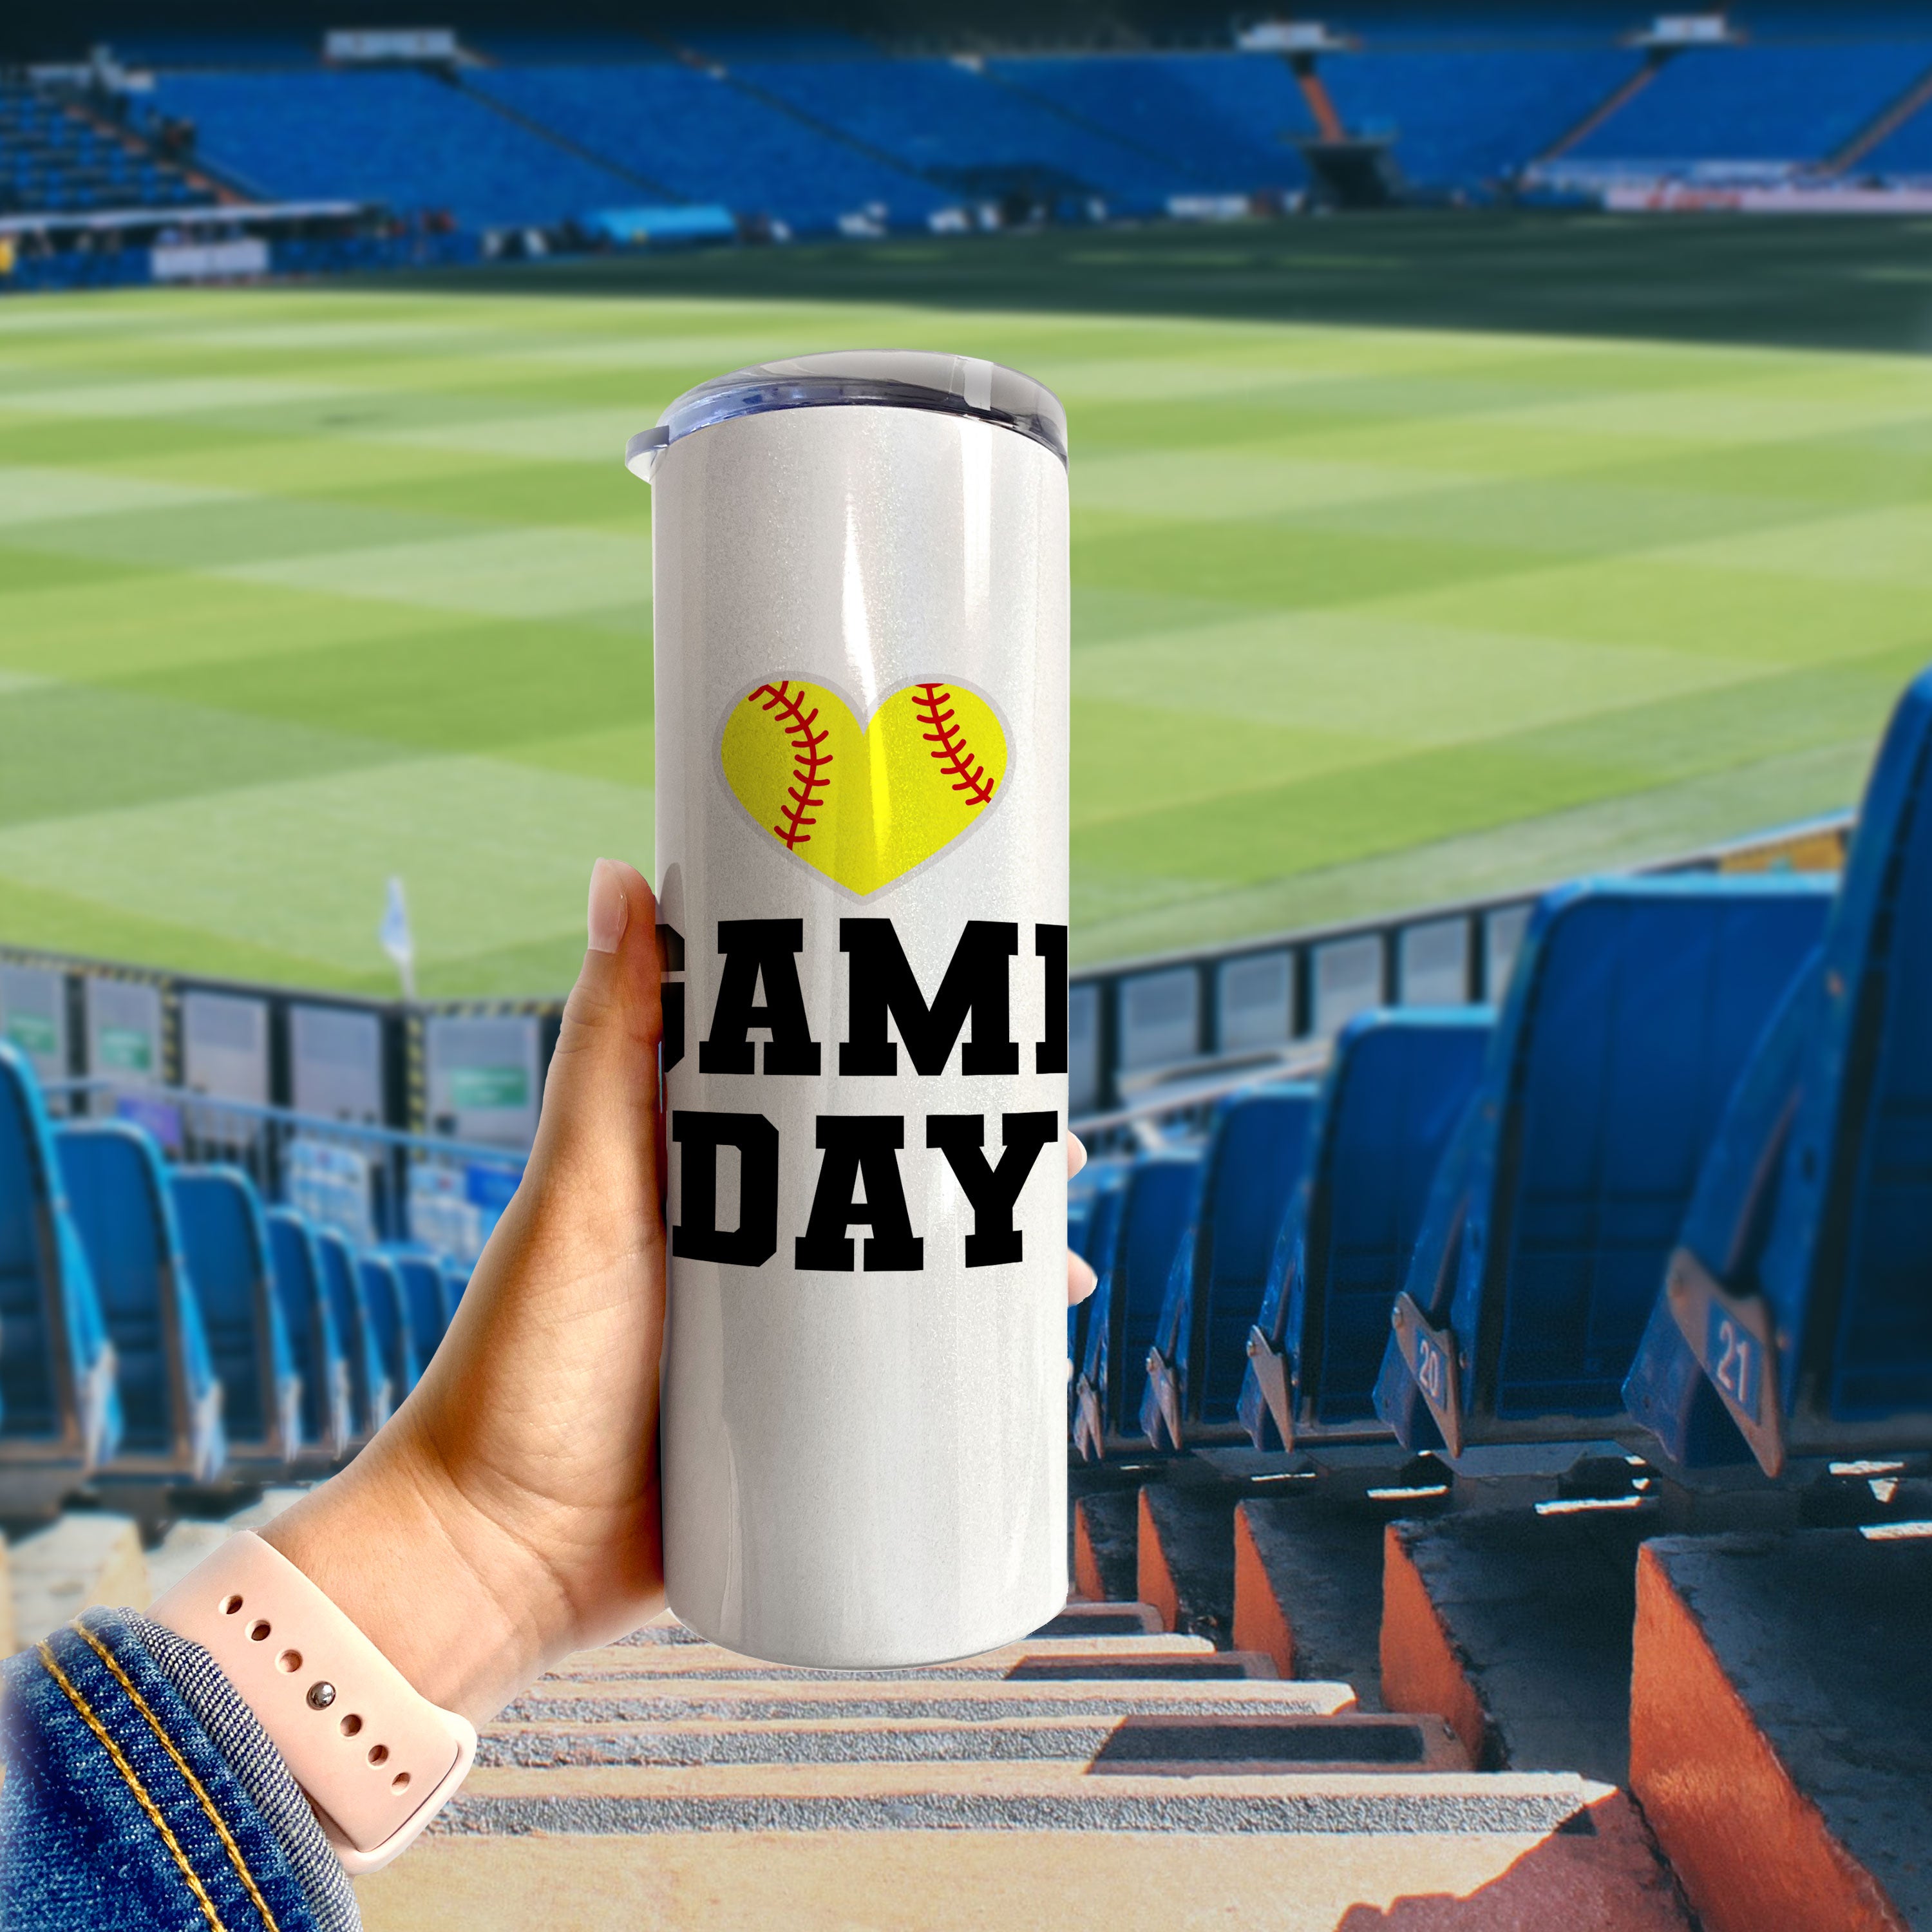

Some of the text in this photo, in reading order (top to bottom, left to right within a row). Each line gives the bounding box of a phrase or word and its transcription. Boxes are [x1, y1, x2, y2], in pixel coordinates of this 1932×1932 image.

[672, 1110, 1058, 1272] DAY
[1419, 1339, 1439, 1397] 20
[1718, 1320, 1750, 1403] 21
